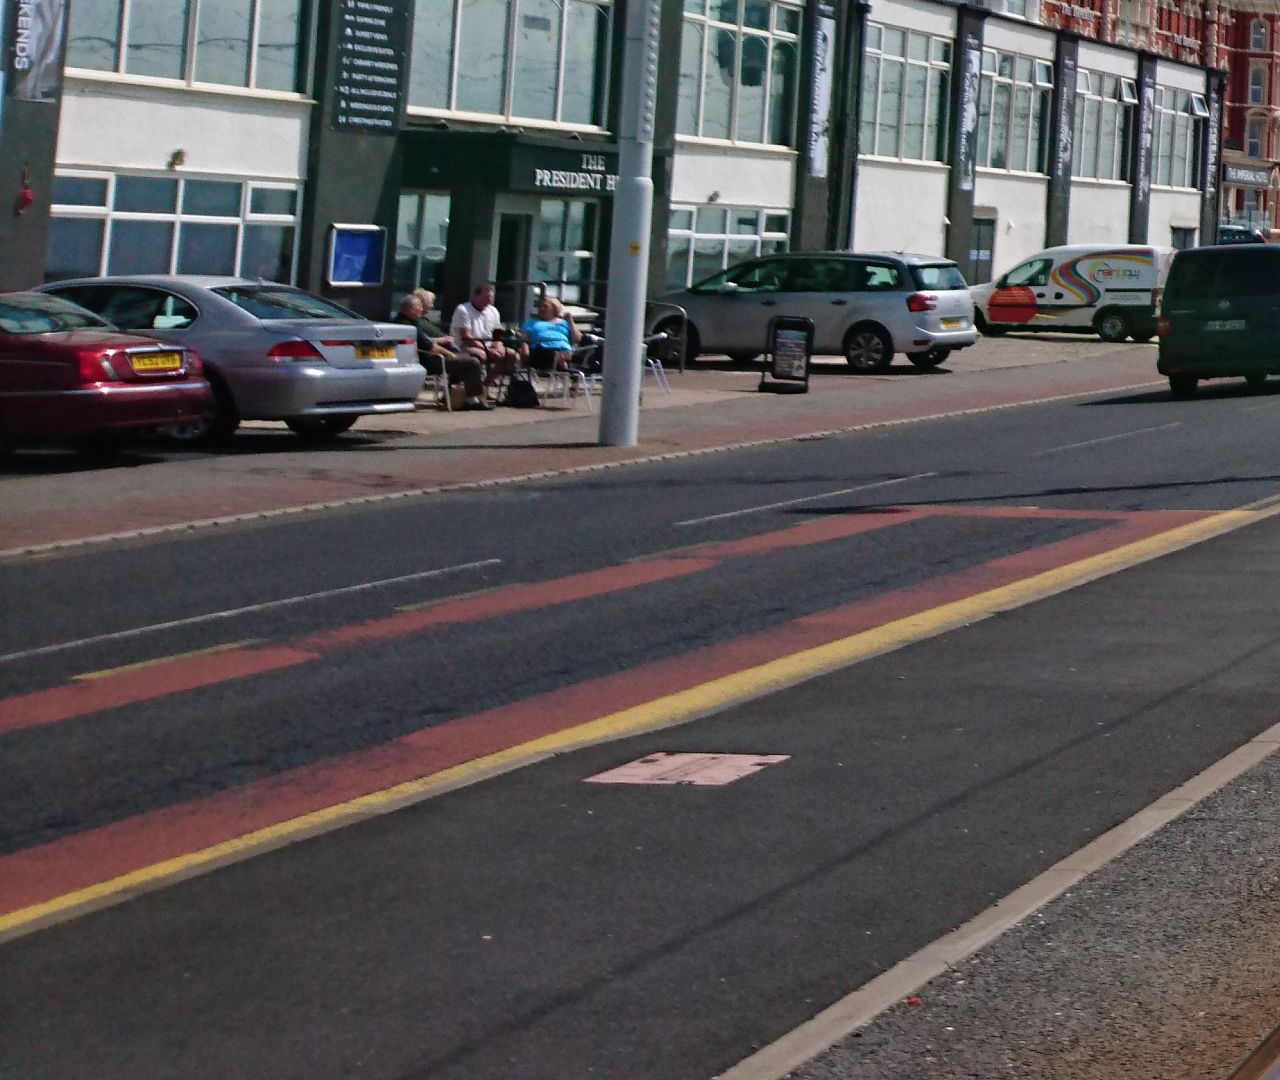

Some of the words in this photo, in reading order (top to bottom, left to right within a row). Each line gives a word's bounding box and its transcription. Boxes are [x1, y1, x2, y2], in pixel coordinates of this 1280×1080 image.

[581, 154, 606, 170] THE
[534, 168, 602, 190] PRESIDENT
[1228, 167, 1237, 179] THE
[1237, 169, 1255, 181] IMPERIAL
[1256, 171, 1268, 182] HOTEL
